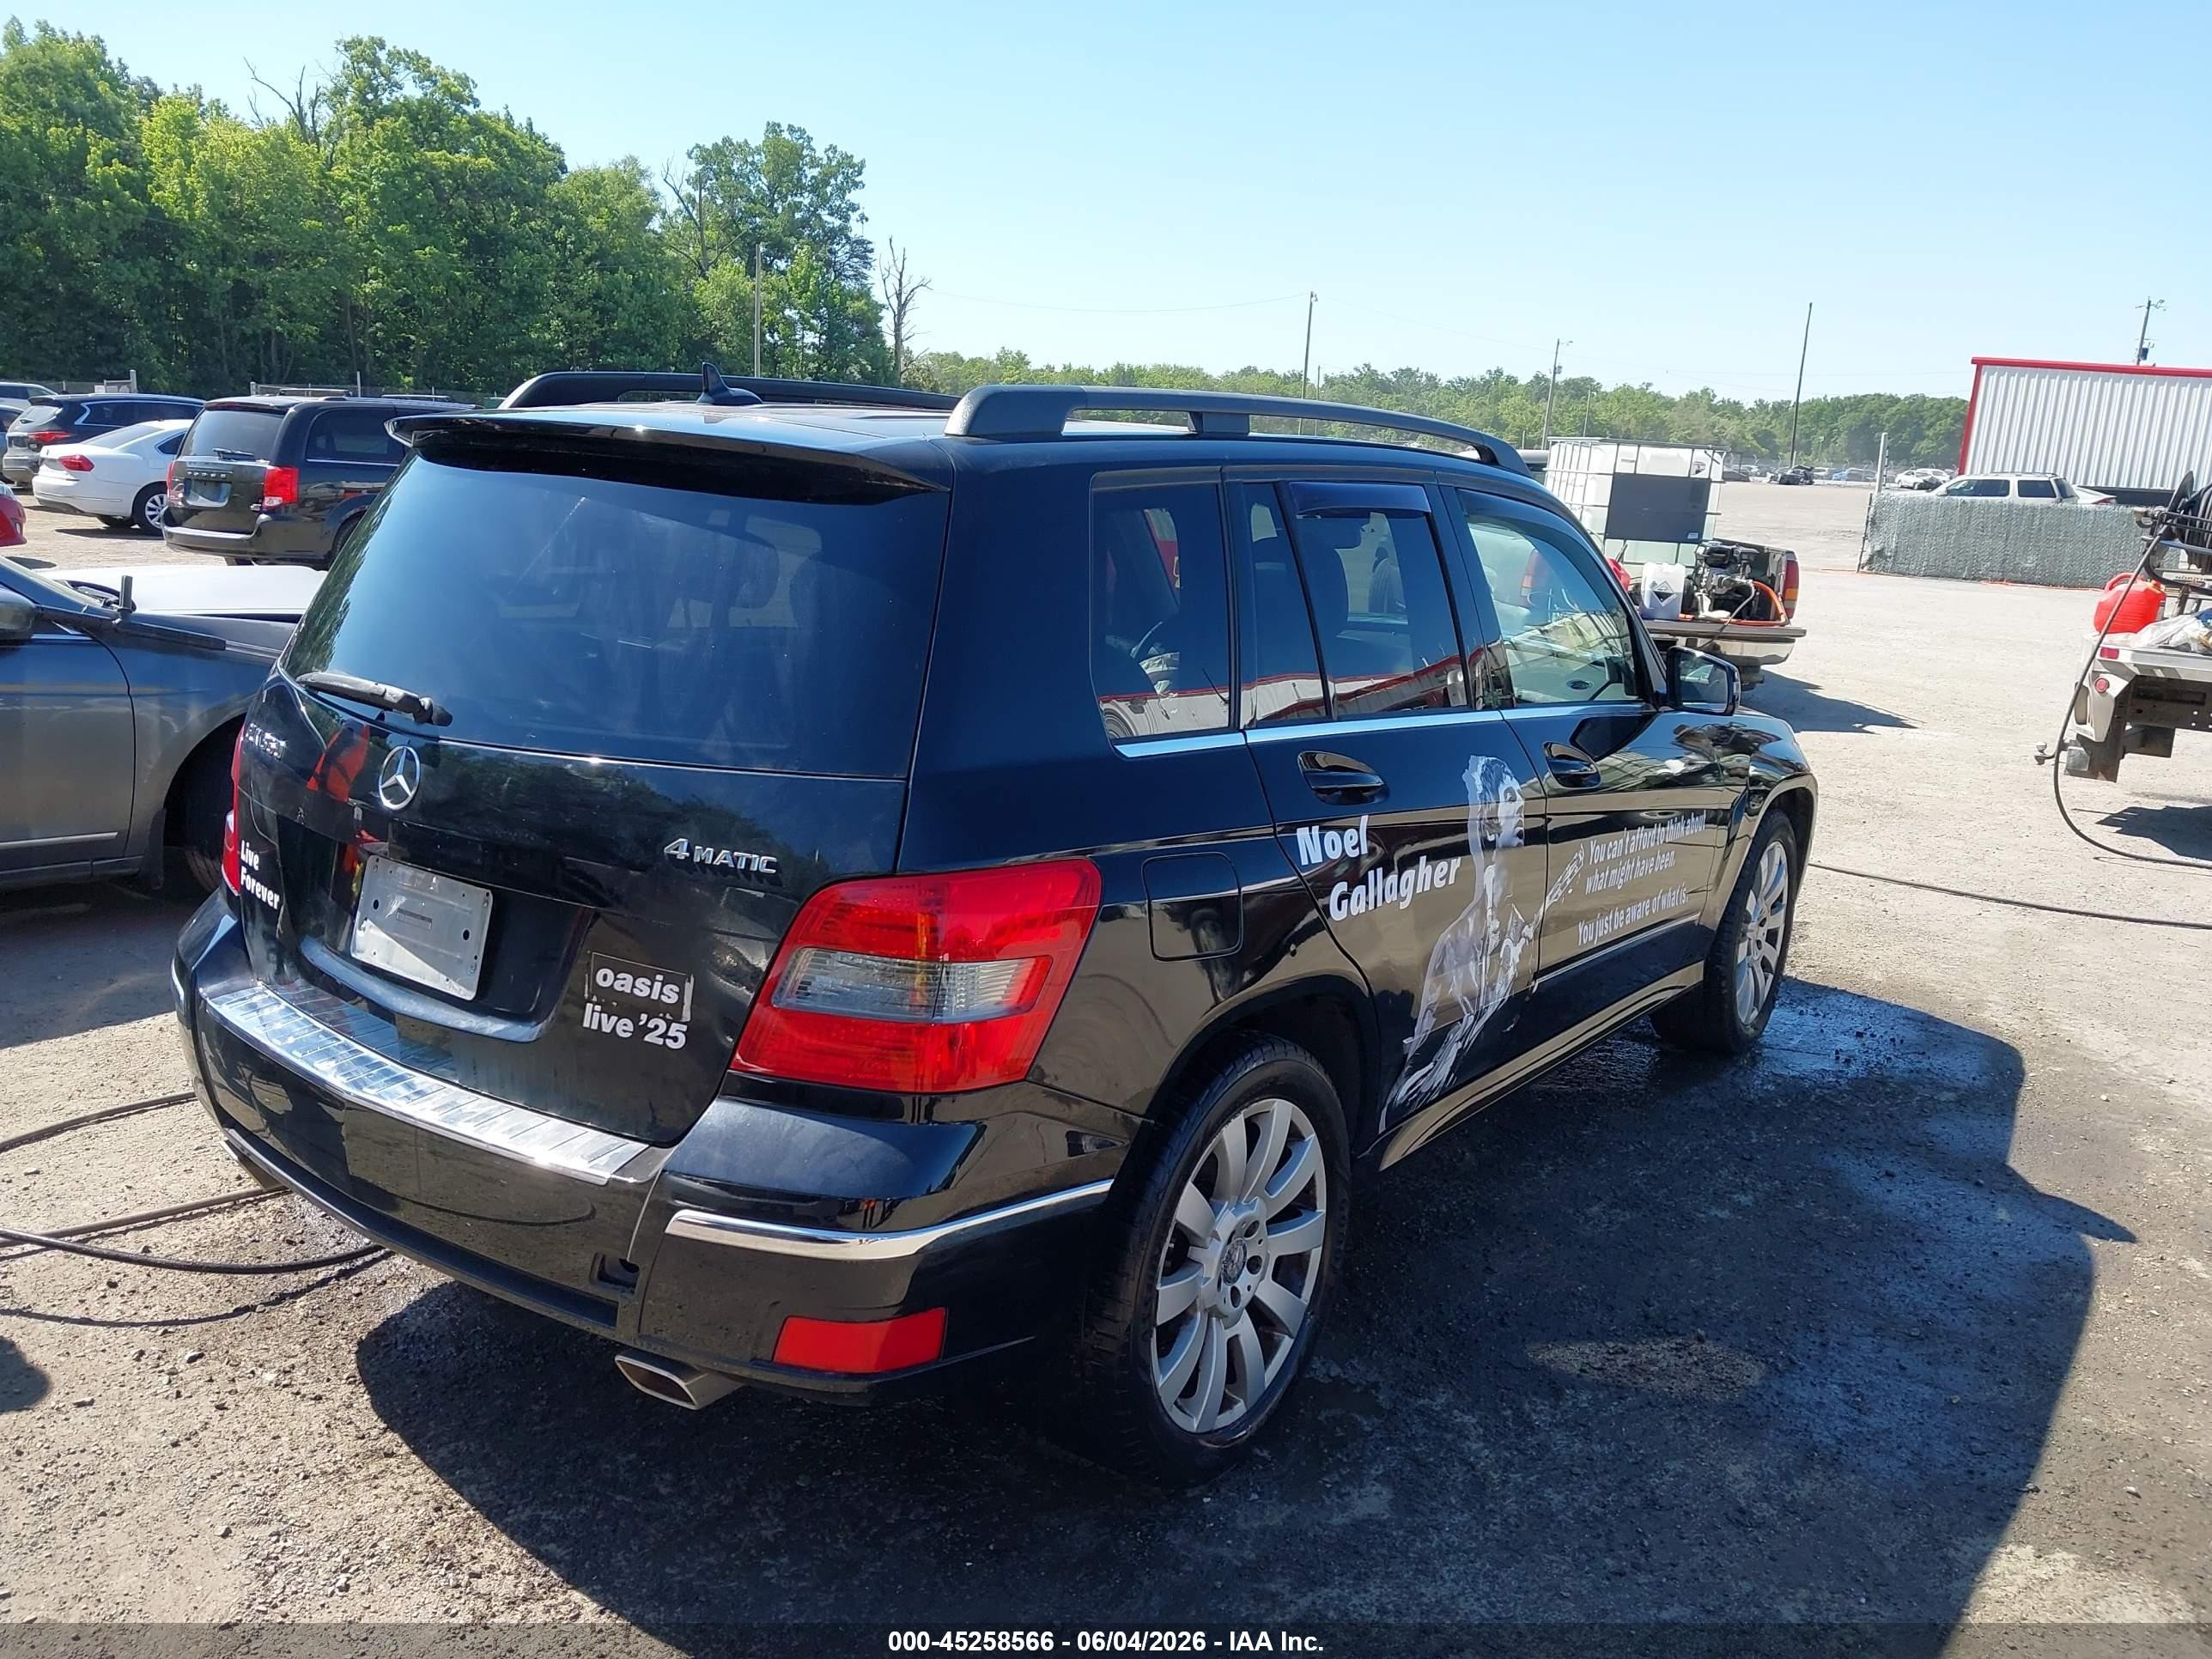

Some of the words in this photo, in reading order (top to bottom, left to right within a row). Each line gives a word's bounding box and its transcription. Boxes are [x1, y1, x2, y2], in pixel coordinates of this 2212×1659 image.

[240, 839, 259, 872] Live
[1296, 815, 1369, 866] Noel
[1589, 839, 1607, 866] You
[1607, 827, 1630, 860] can't
[1629, 823, 1657, 854] afford
[1656, 823, 1666, 846] to
[1666, 814, 1686, 842] think
[1686, 809, 1707, 836] about
[240, 865, 280, 910] Forever
[1330, 855, 1462, 921] Gallagher
[1585, 866, 1611, 896] what
[1607, 858, 1636, 890] might
[1633, 855, 1656, 878] have
[1578, 920, 1595, 946] You
[1593, 909, 1613, 945] just
[1613, 906, 1625, 930] be
[1626, 898, 1650, 926] aware
[1651, 889, 1663, 915] of
[1662, 885, 1680, 910] what
[595, 968, 681, 1004] oasis
[582, 1002, 635, 1038] live
